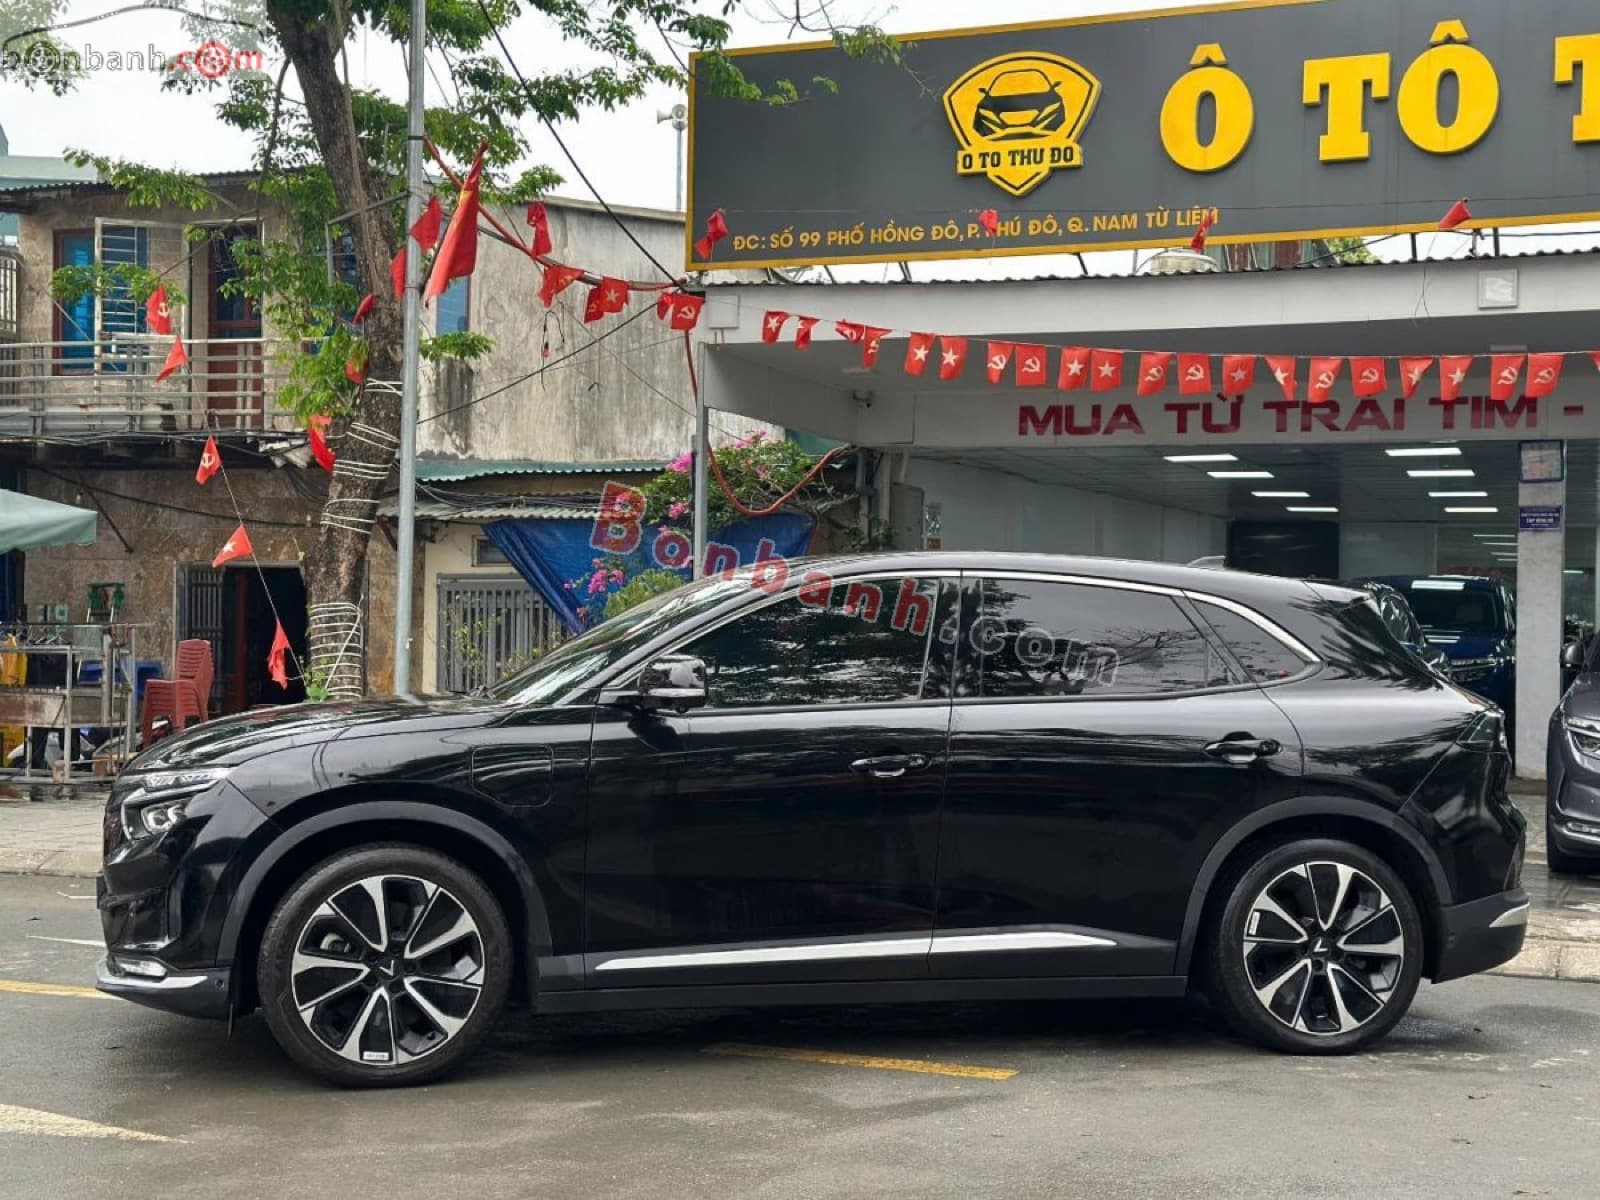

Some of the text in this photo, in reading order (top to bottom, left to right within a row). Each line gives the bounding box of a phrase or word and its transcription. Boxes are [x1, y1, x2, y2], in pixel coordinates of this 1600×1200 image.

[1160, 43, 1255, 173] Ô
[1303, 19, 1500, 163] TÔ
[979, 151, 1001, 168] TO
[1008, 148, 1045, 166] THU
[733, 235, 766, 250] ĐC:
[770, 225, 794, 248] SỐ
[800, 232, 821, 246] 99
[827, 222, 865, 245] PHỐ
[870, 219, 925, 244] HỒNG
[931, 220, 964, 242] ĐÔ,
[985, 215, 1022, 238] HÚ
[1028, 214, 1062, 237] ĐÔ,
[1067, 216, 1089, 232] Q.
[1093, 213, 1138, 231] NAM
[1145, 206, 1170, 228] TỪ
[1018, 404, 1145, 435] MUA
[1164, 393, 1244, 433] TỪ
[1429, 396, 1537, 429] TIM
